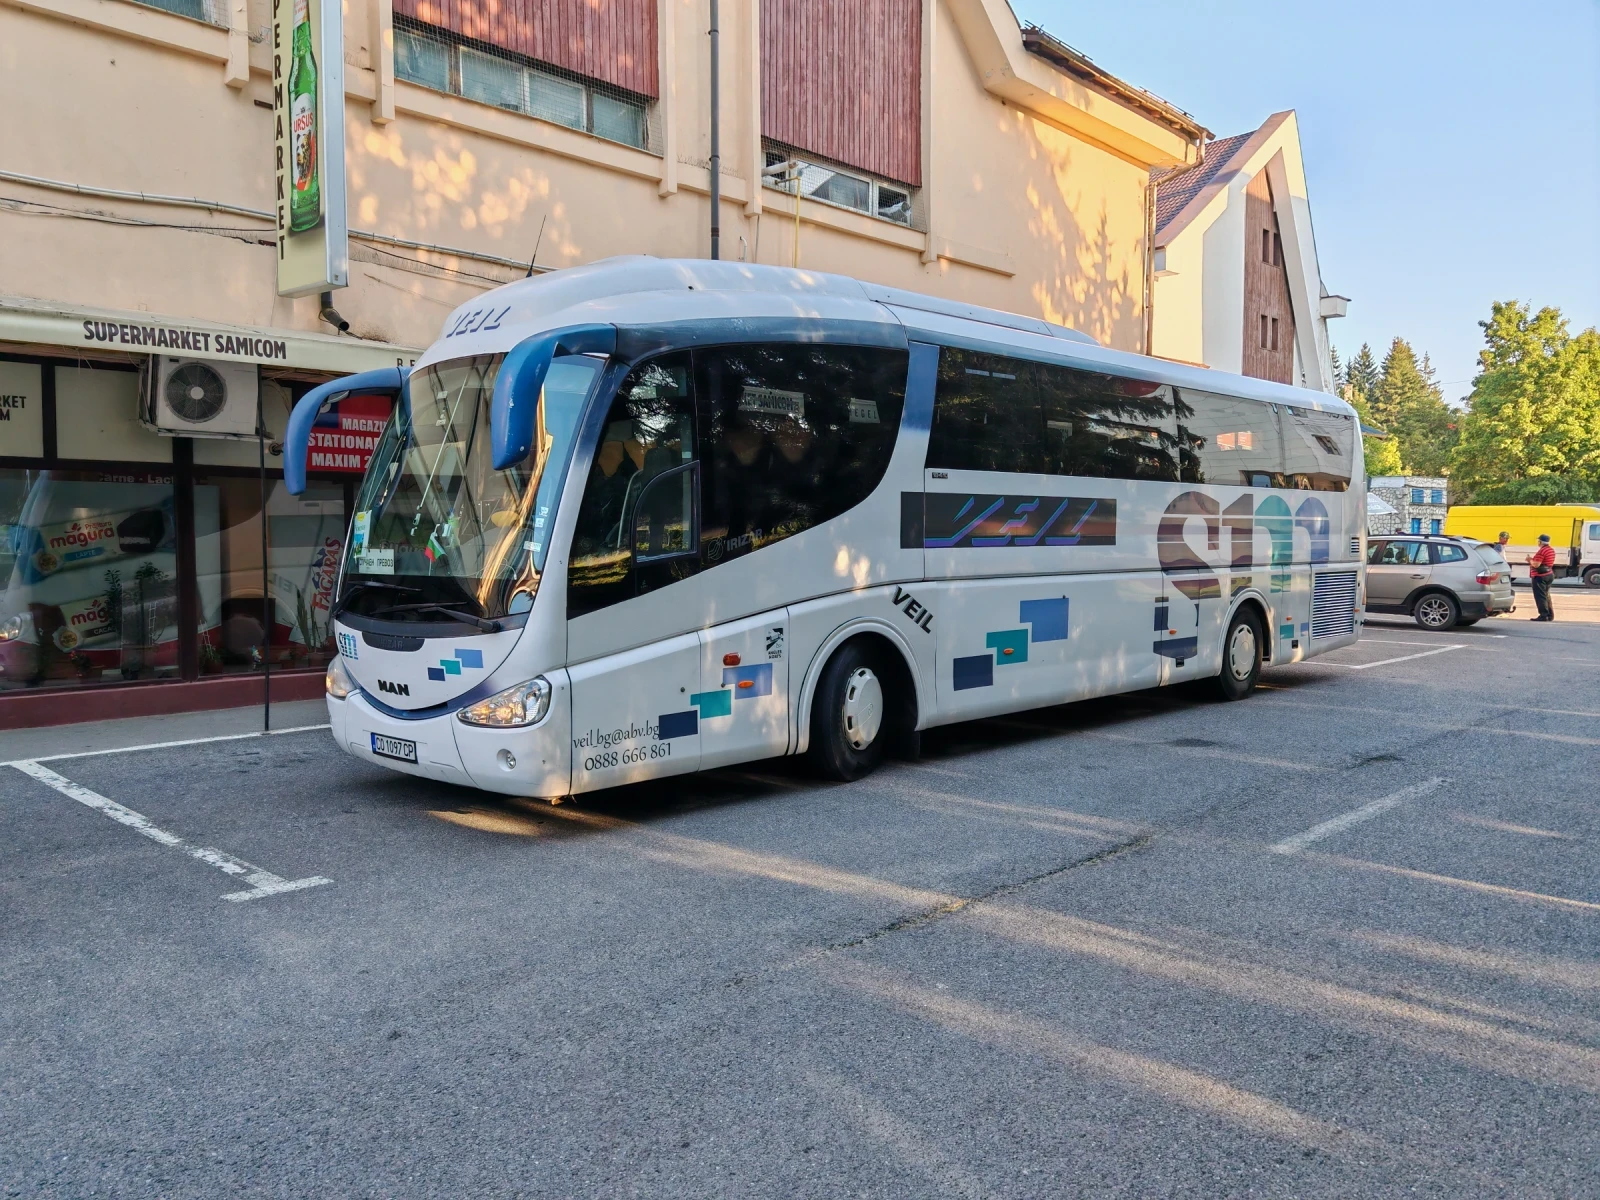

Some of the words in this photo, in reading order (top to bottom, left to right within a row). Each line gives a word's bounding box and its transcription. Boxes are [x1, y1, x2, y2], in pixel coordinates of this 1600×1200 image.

[293, 112, 313, 133] URSUS
[83, 320, 210, 352] SUPERMARKET
[214, 334, 286, 359] SAMICOM
[311, 452, 361, 468] MAXIM
[891, 585, 934, 635] VEIL
[377, 679, 410, 696] MAN
[573, 720, 660, 749] veil_bg@abv.bg
[386, 739, 402, 755] 1097
[403, 743, 414, 758] CP
[584, 751, 619, 771] 0888
[622, 746, 647, 764] 666
[650, 742, 671, 760] 861
